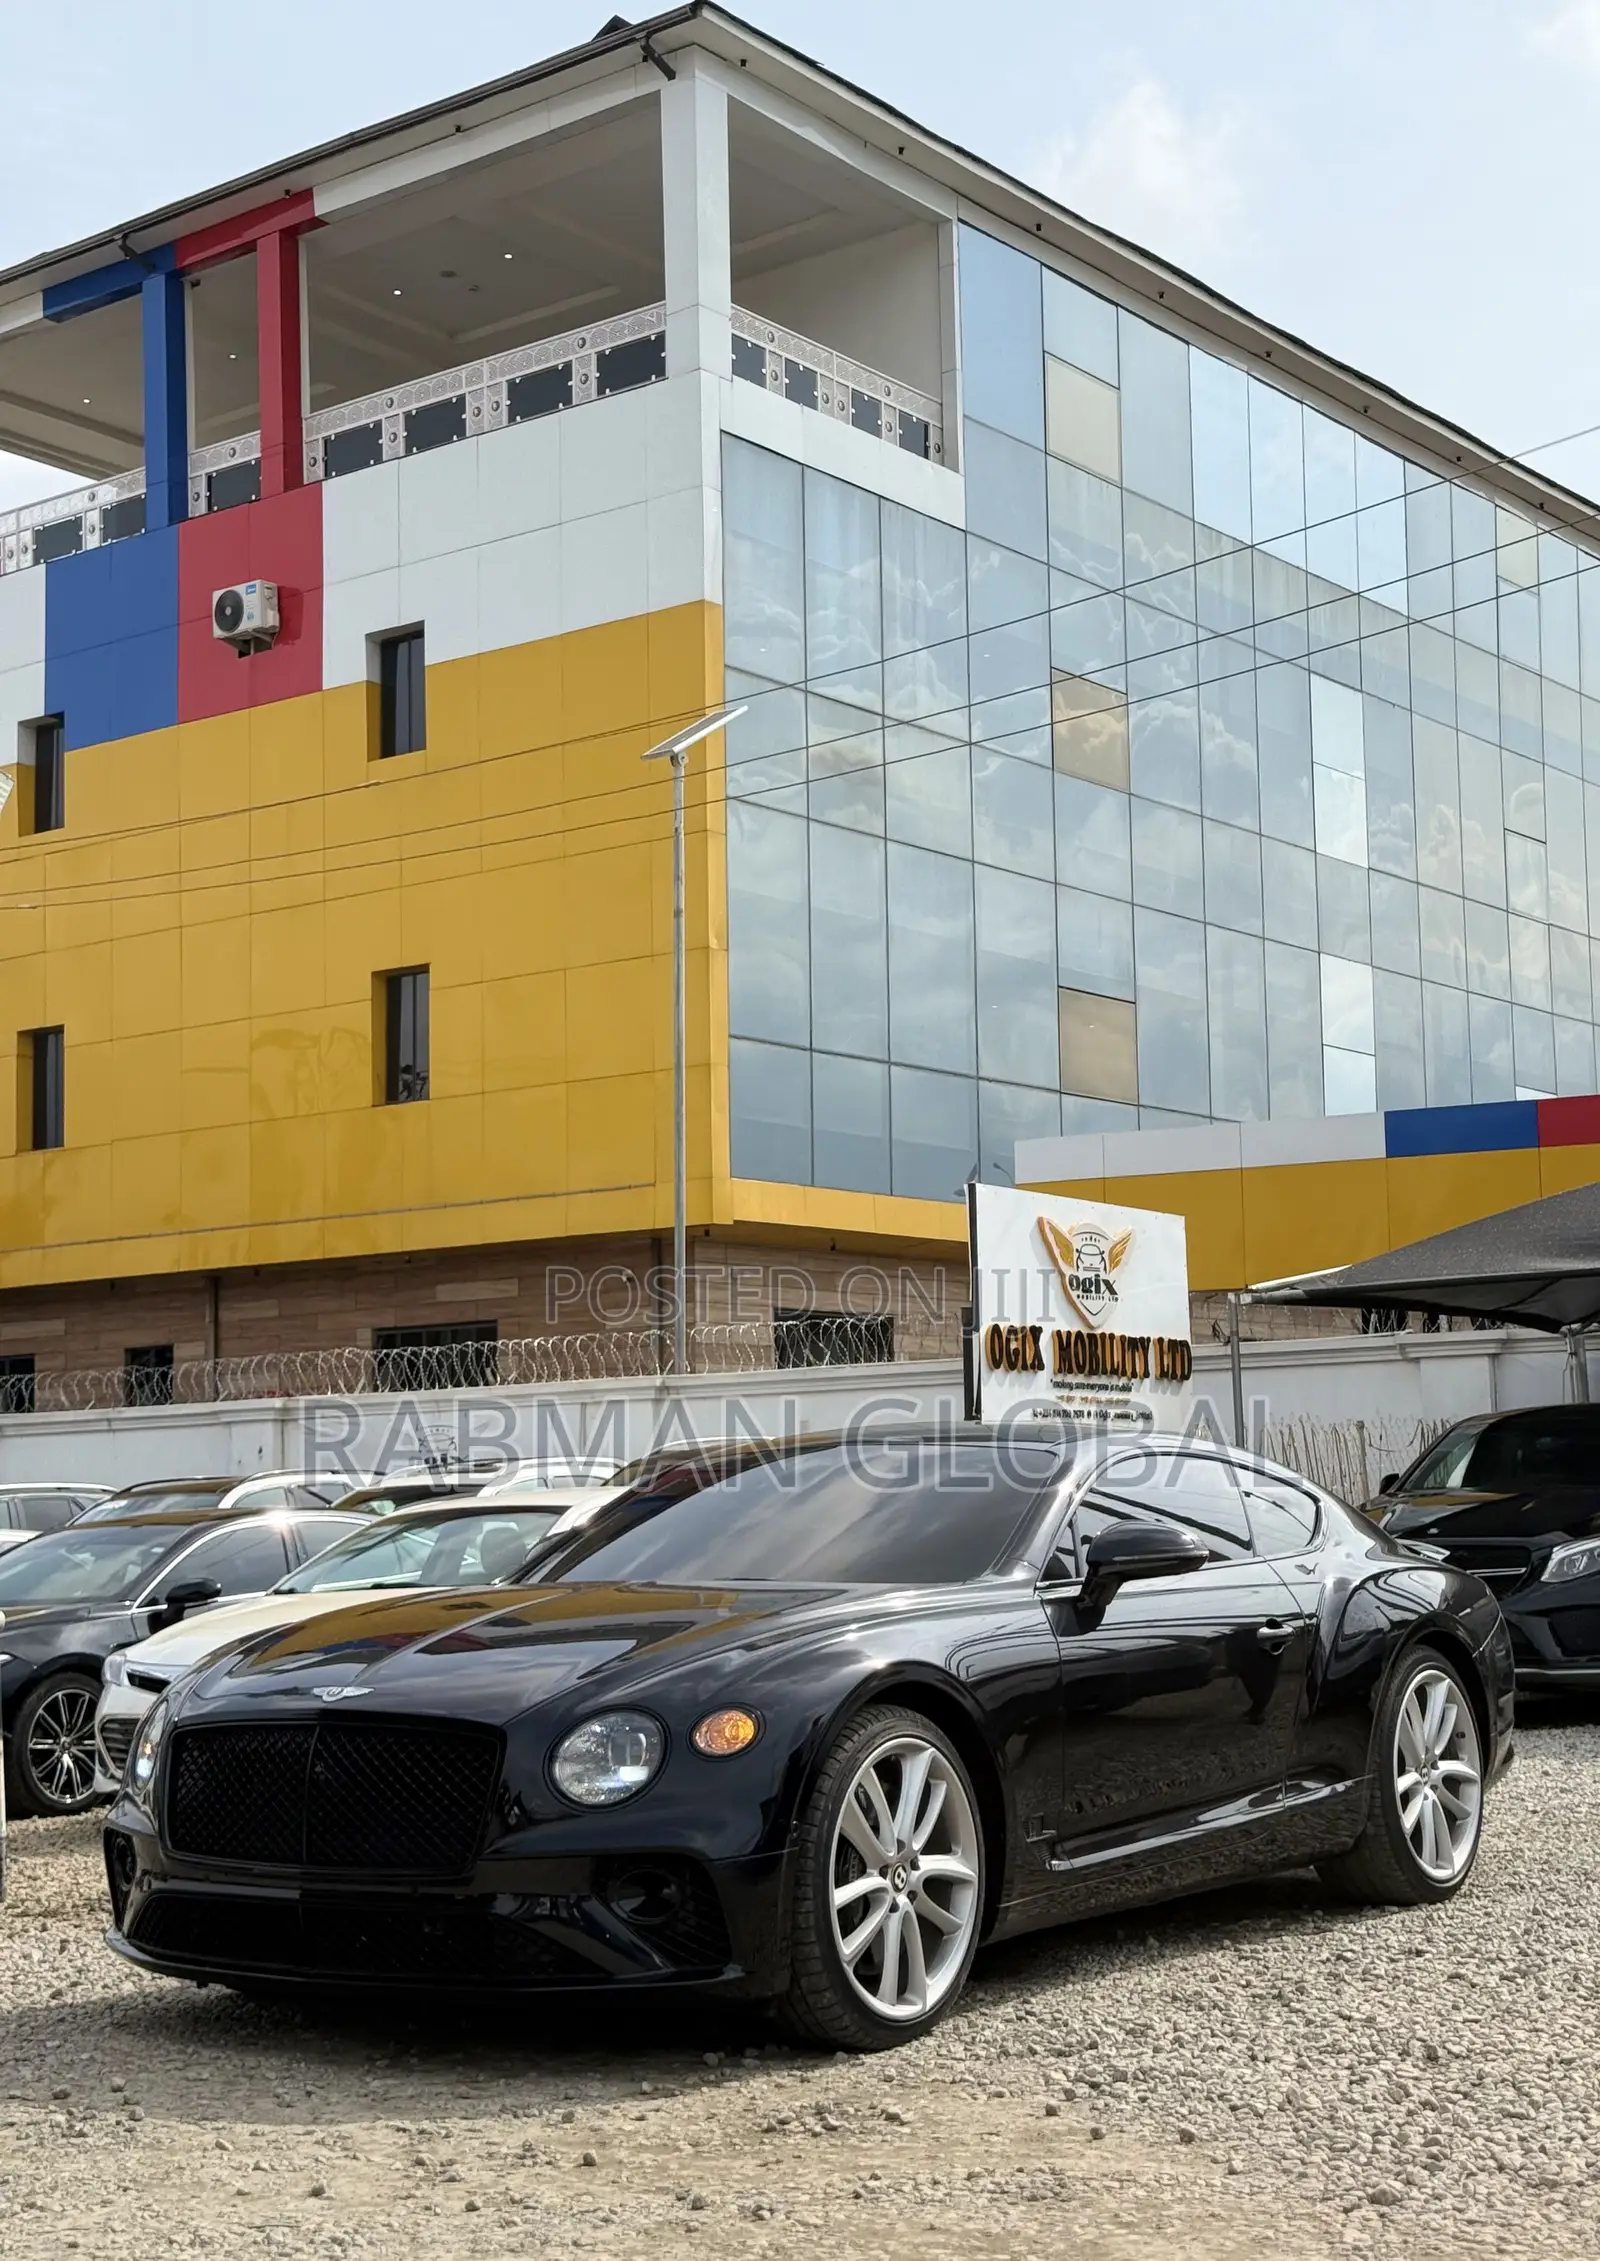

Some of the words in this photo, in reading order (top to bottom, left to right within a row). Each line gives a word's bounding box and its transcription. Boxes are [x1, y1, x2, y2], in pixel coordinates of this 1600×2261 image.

[985, 1323, 1045, 1372] OGIX
[1052, 1329, 1151, 1379] MOBILITY
[1153, 1336, 1193, 1381] LTD
